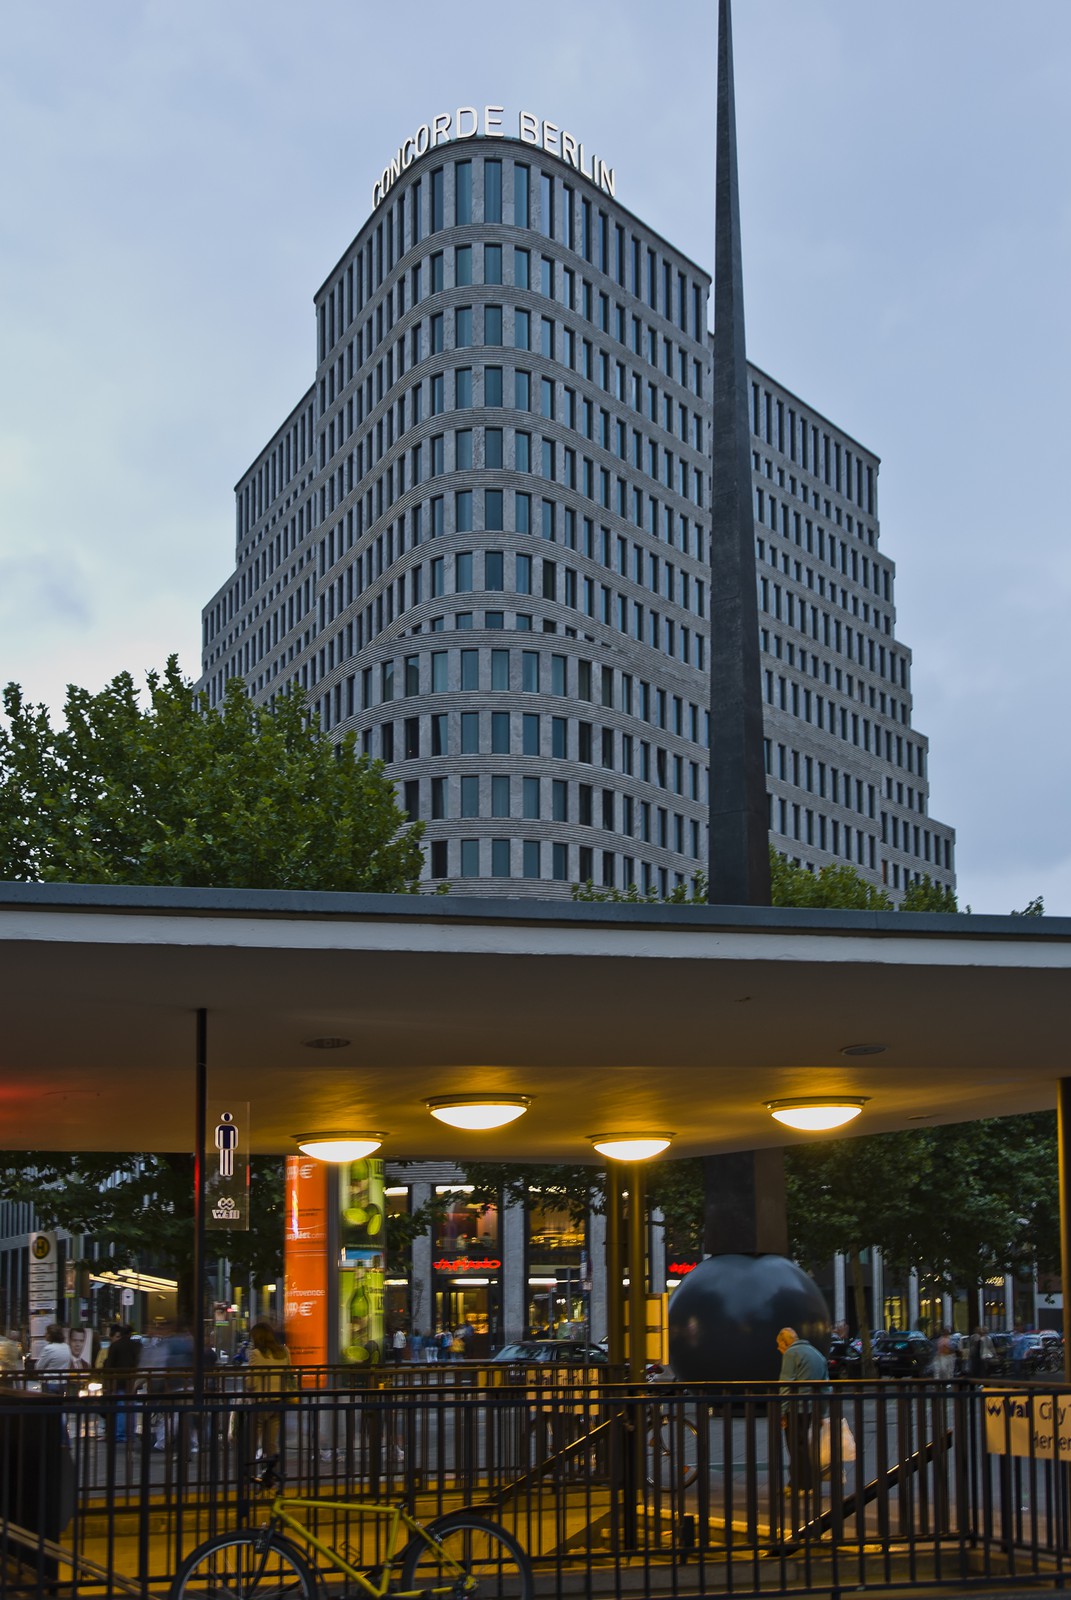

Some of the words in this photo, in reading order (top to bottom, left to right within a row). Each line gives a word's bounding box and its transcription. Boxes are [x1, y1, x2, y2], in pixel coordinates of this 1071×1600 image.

[372, 105, 504, 209] CONCORDE
[519, 110, 616, 197] BERLIN
[1003, 1399, 1031, 1418] Wal
[1039, 1402, 1066, 1426] Ciy
[1032, 1431, 1071, 1451] Here
